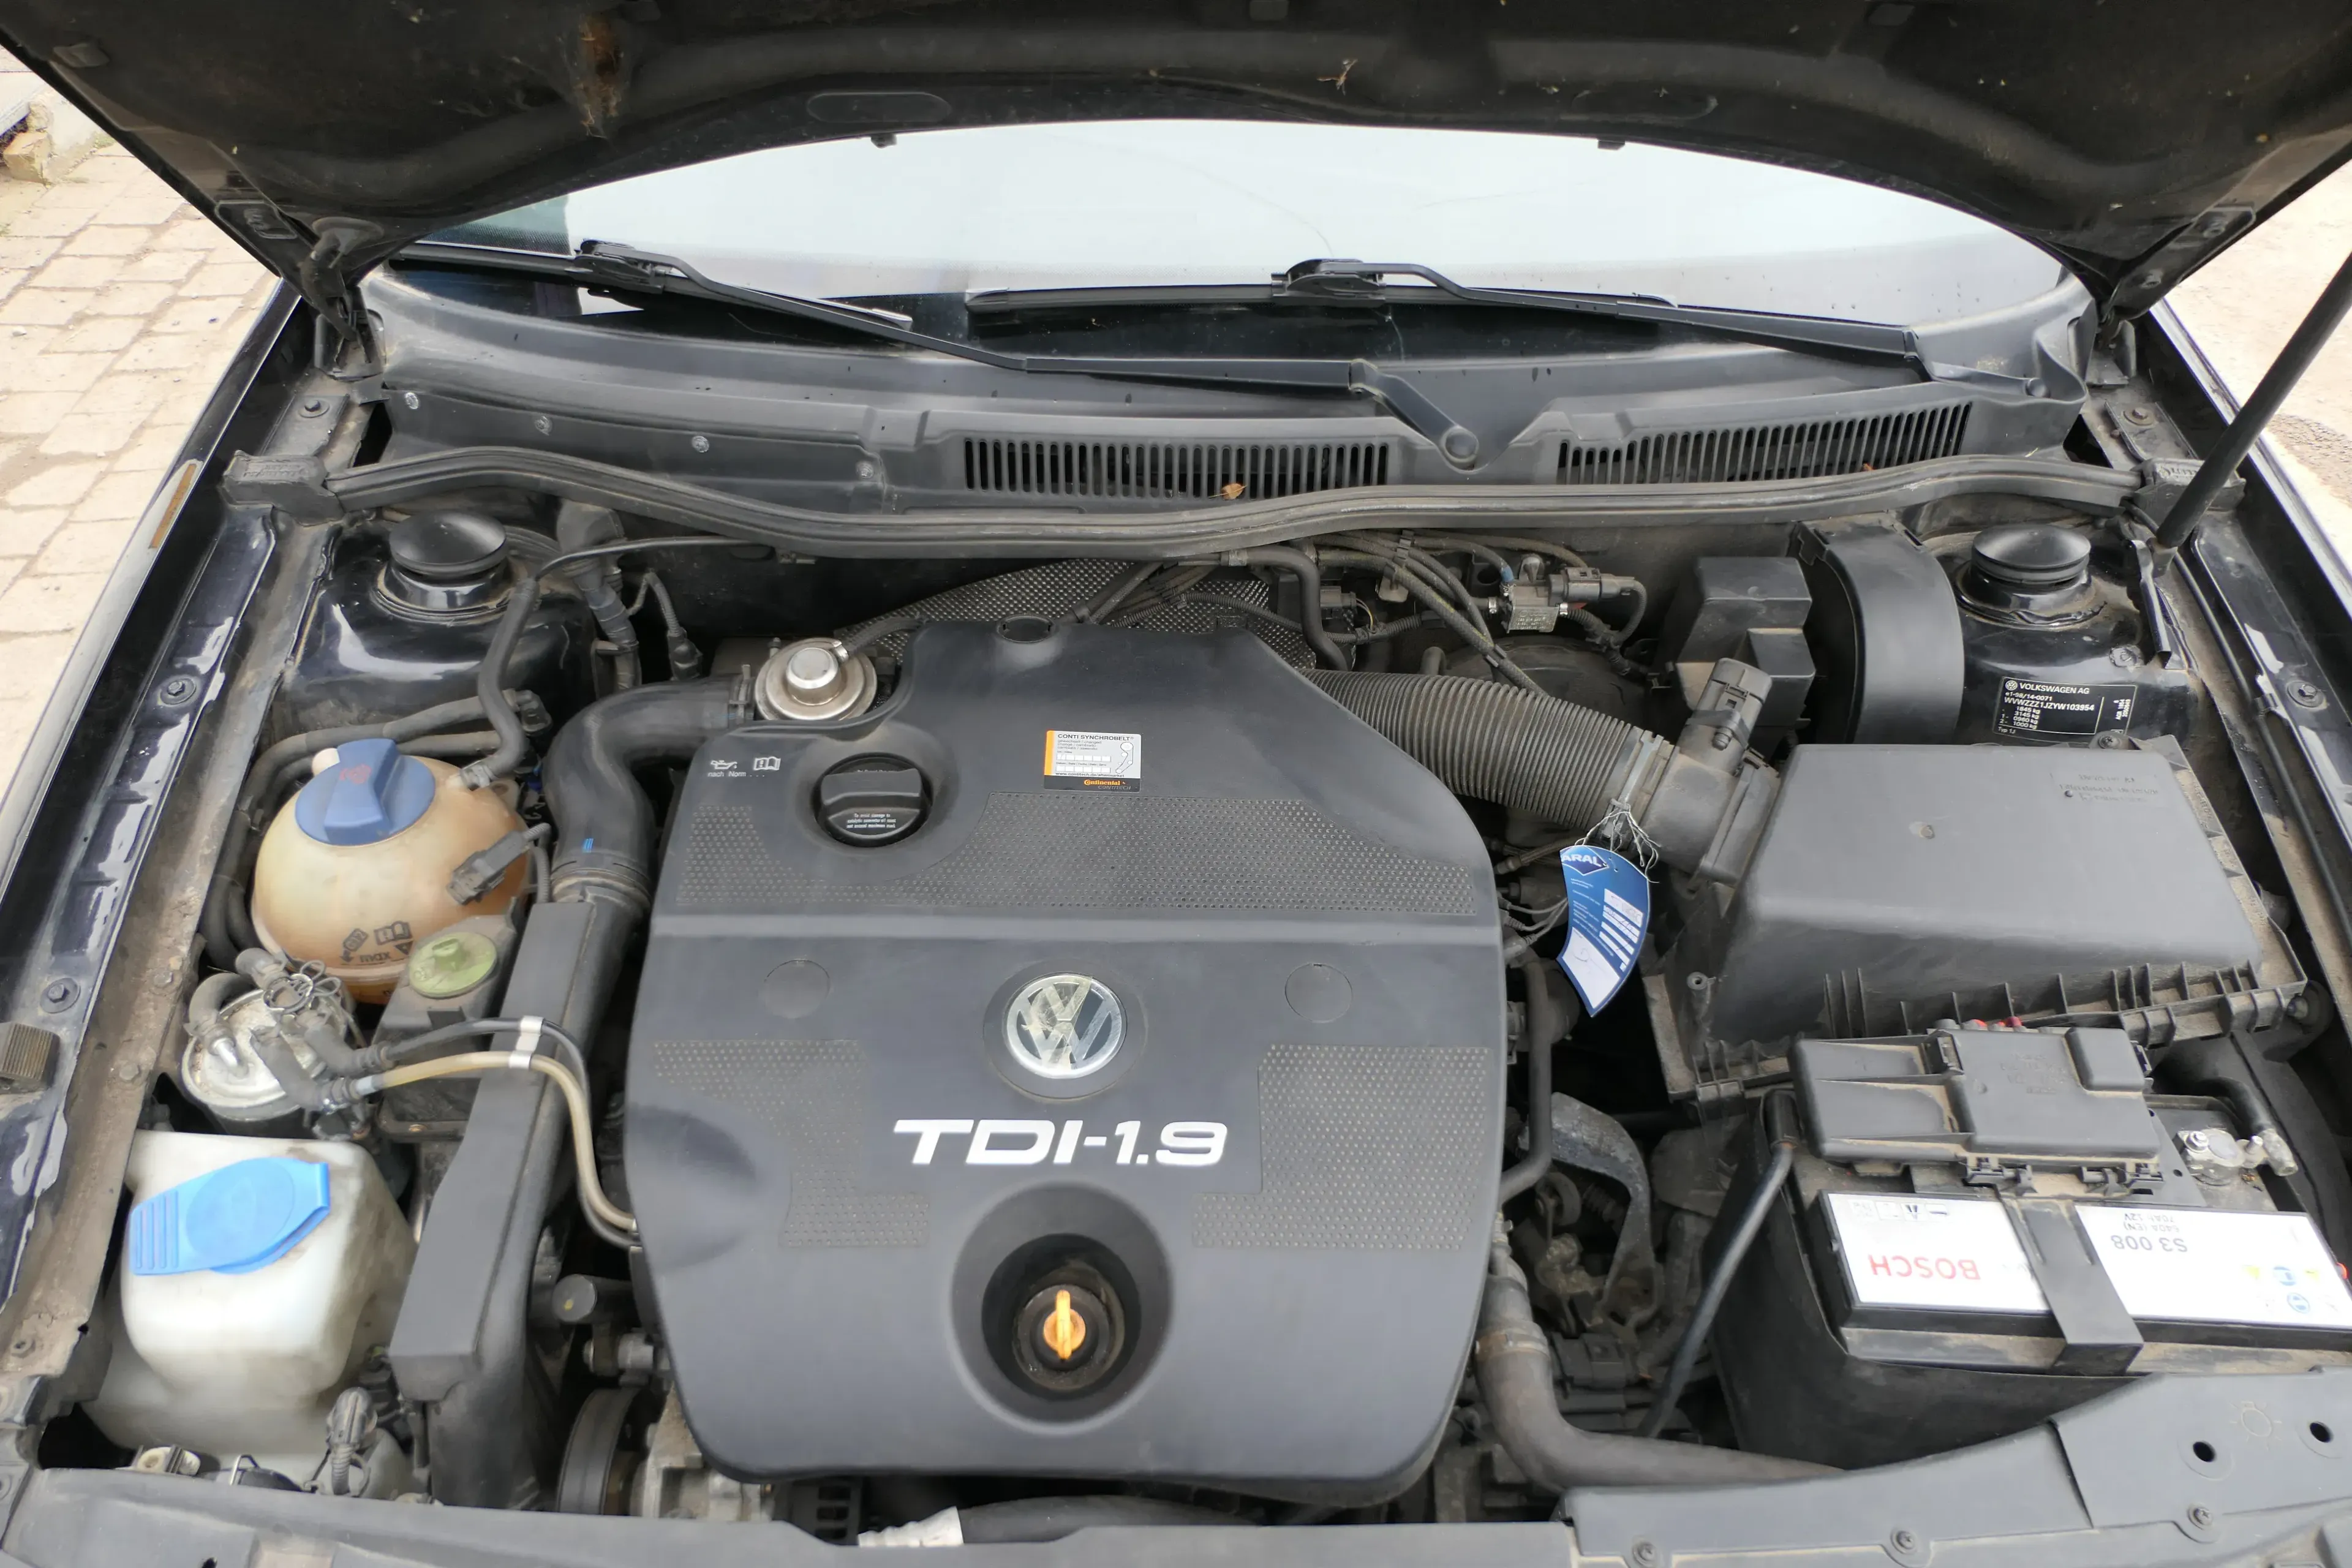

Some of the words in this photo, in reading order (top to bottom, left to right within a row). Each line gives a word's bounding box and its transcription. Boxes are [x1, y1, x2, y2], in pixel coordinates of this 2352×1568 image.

[2019, 683, 2076, 693] VOLKSWAGEN
[2004, 697, 2095, 711] WVWZZZ1JZYW103954
[1561, 853, 1602, 867] ARAL
[360, 951, 390, 963] max
[2110, 1234, 2152, 1251] 008
[2158, 1236, 2188, 1253] S3
[1868, 1254, 1981, 1280] BOSCH
